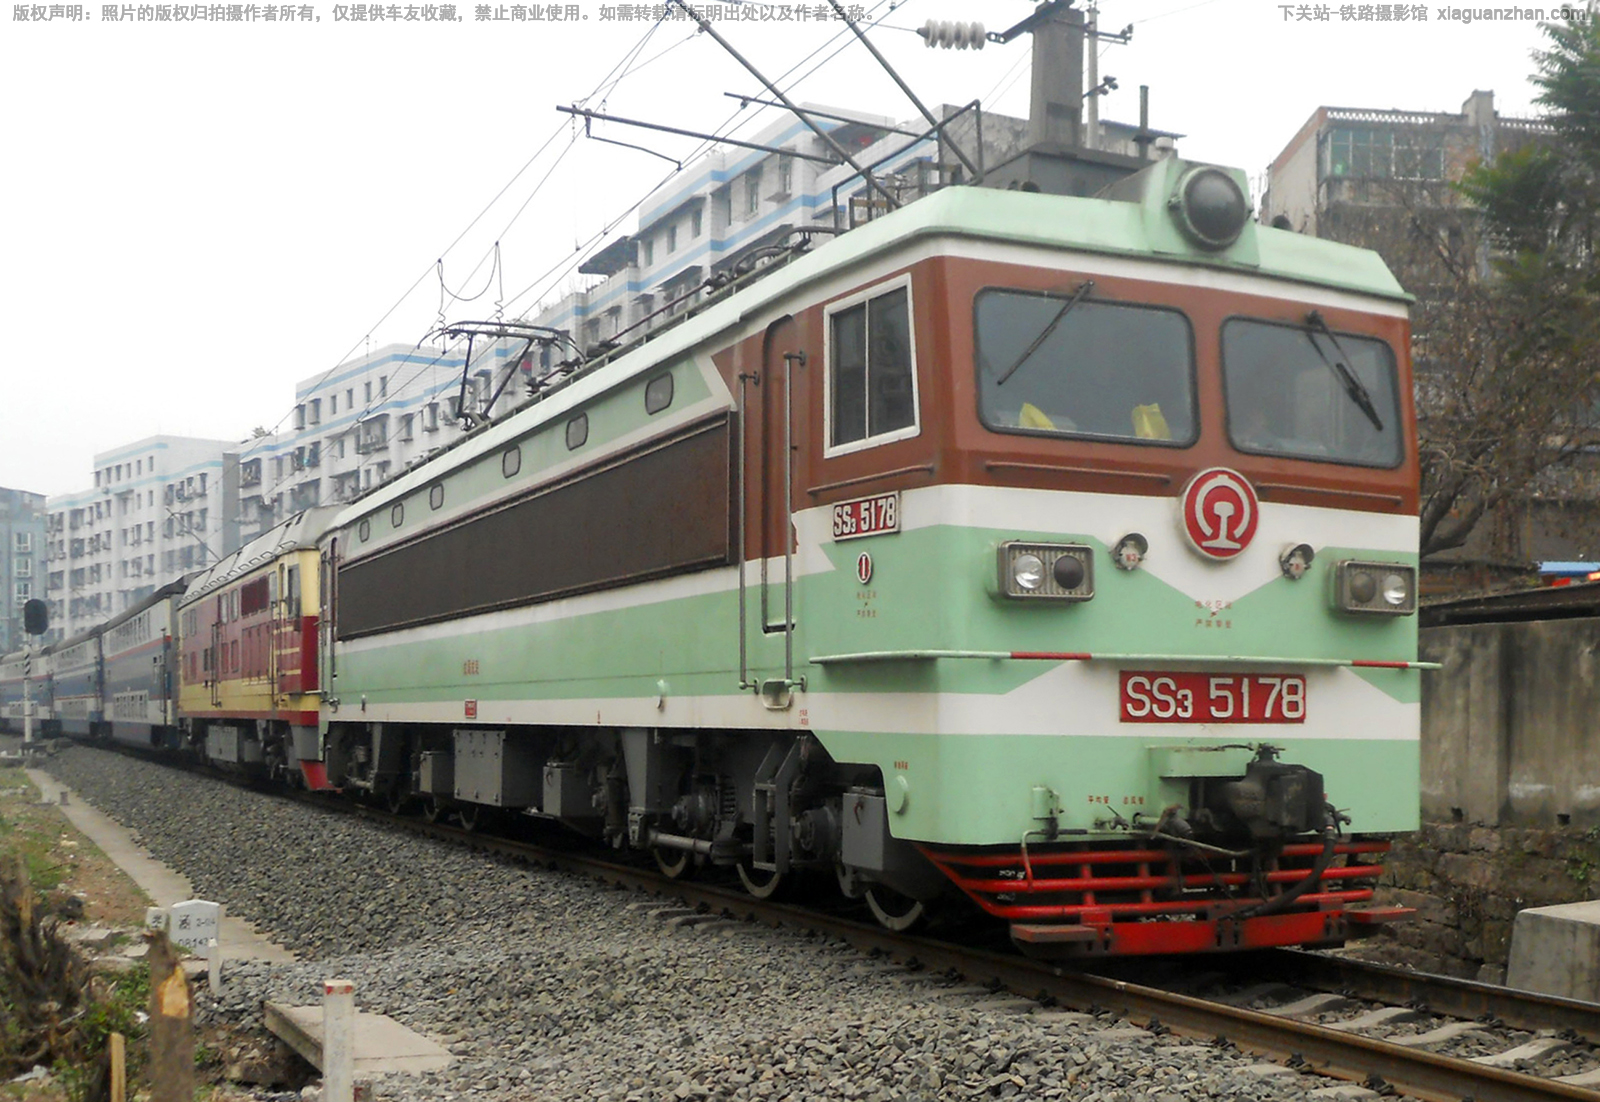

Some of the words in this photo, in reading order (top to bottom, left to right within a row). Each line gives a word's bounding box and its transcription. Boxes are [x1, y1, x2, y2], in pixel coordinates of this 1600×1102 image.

[833, 504, 857, 537] SS3
[860, 496, 897, 532] 5178
[1126, 676, 1194, 719] SS3
[1209, 677, 1305, 719] 5178
